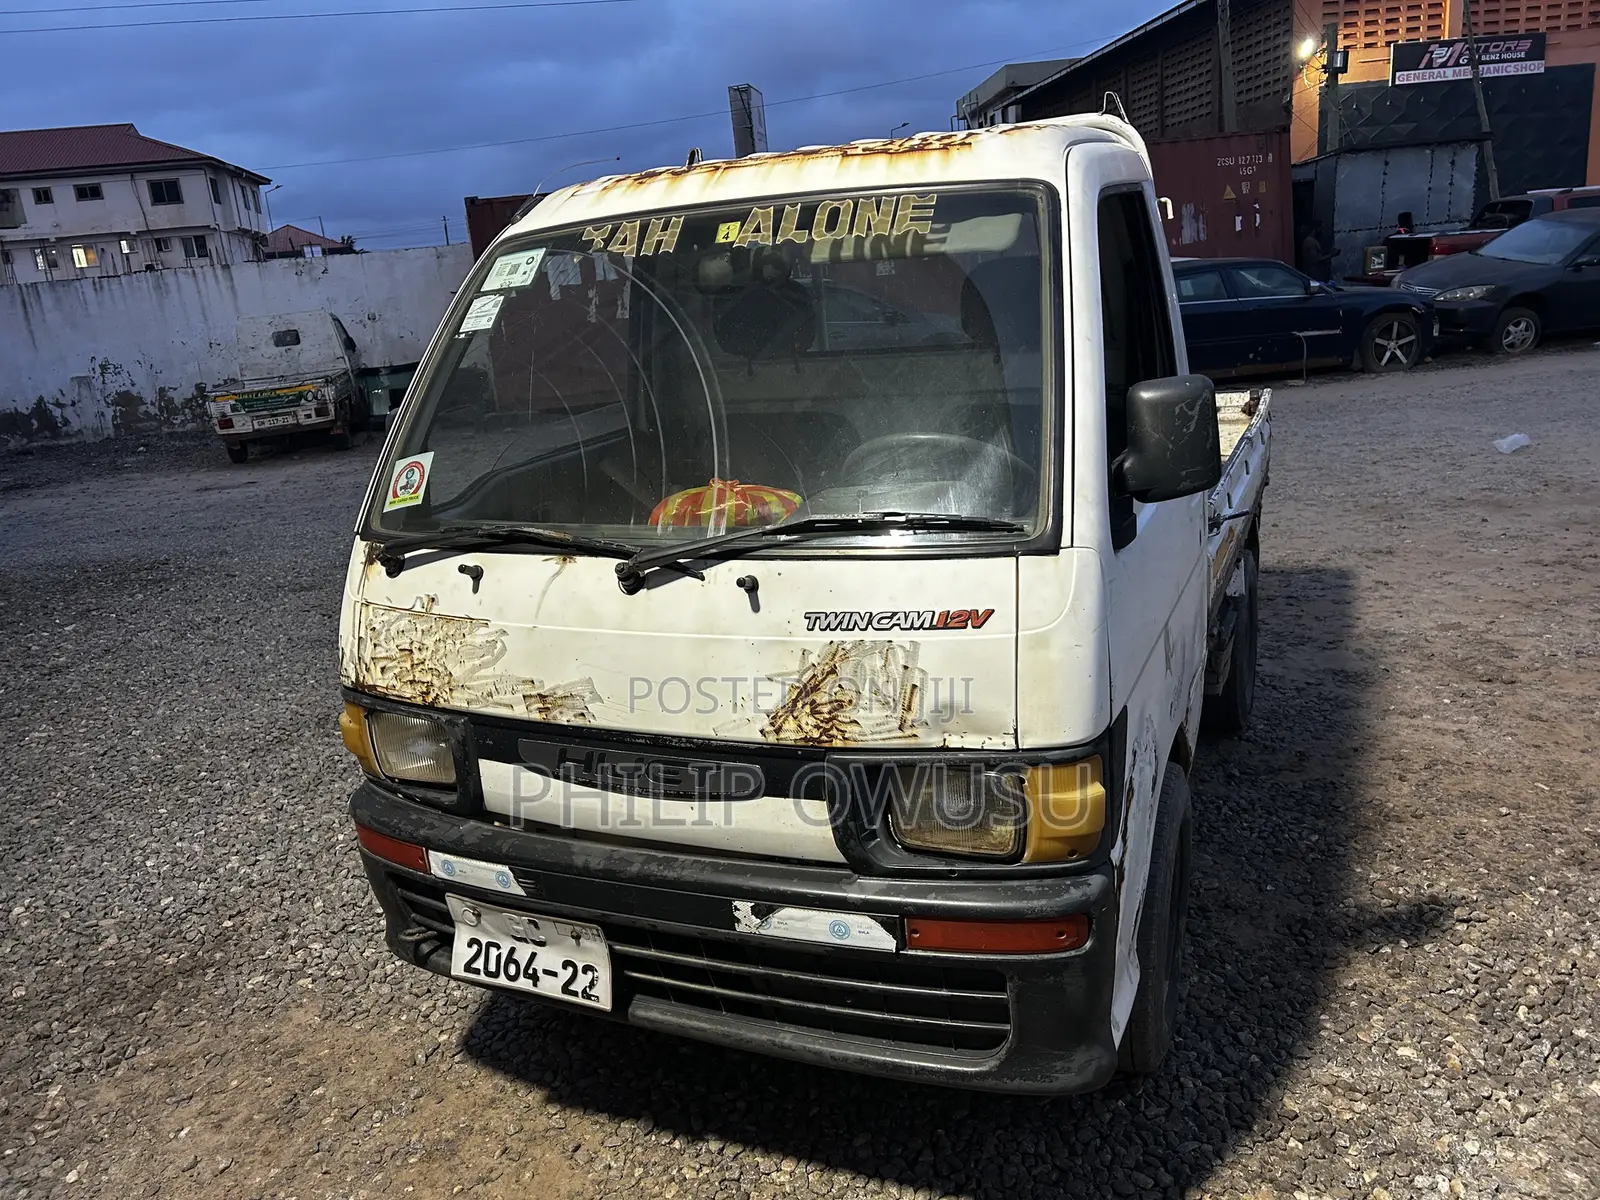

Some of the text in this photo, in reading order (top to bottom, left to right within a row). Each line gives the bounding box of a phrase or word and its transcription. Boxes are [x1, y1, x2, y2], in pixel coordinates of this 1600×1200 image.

[1397, 71, 1449, 83] GENERAL
[733, 193, 938, 248] ALONE
[934, 608, 996, 631] 12V
[463, 937, 600, 1003] 2064-22
